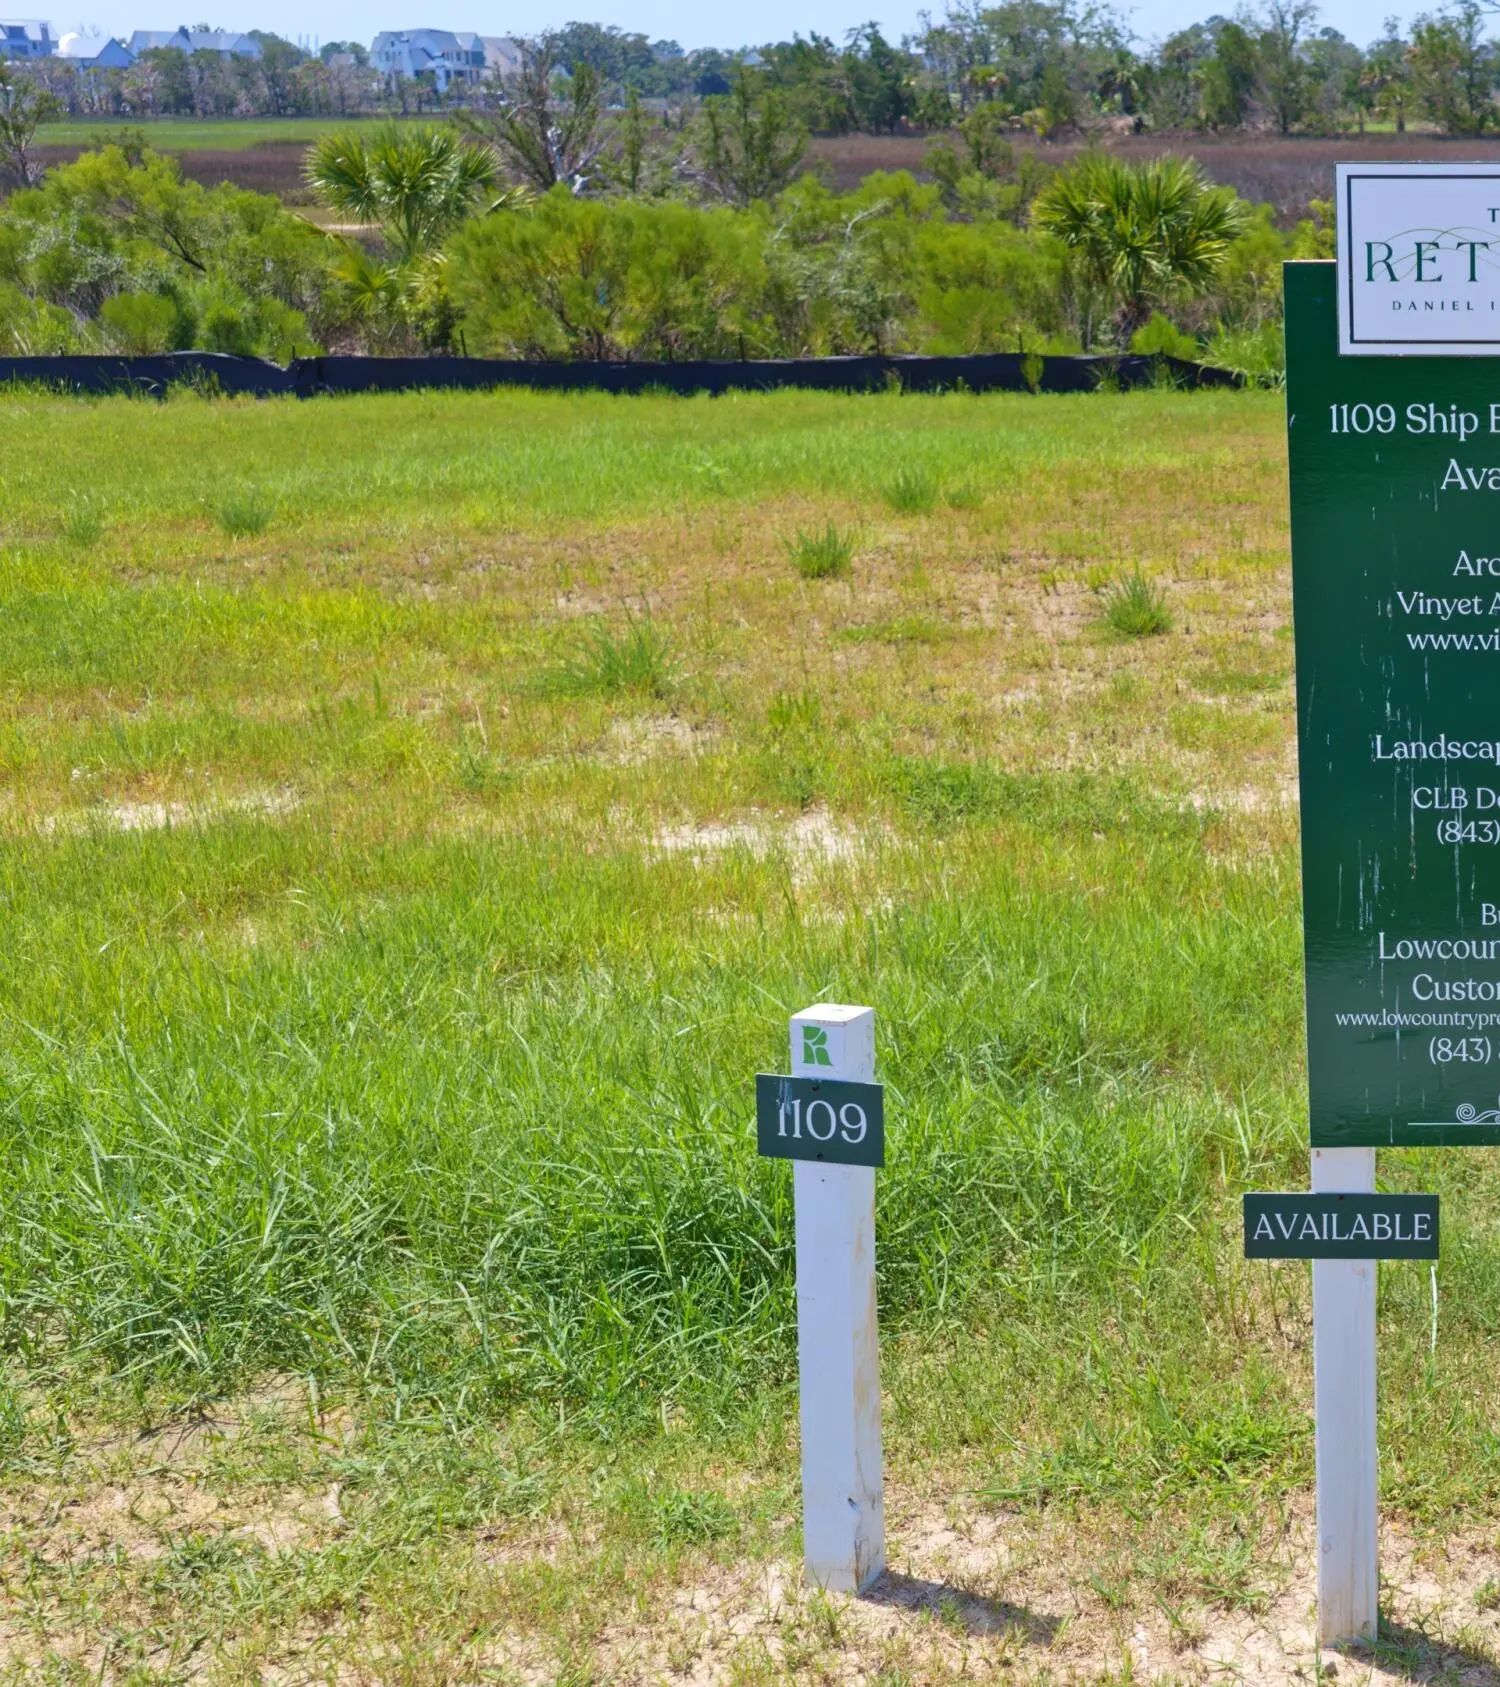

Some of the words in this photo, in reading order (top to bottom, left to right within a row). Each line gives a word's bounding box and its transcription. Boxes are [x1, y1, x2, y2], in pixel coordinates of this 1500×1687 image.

[1391, 299, 1475, 312] DANIEL
[1329, 403, 1396, 434] 1109
[1406, 402, 1478, 442] Ship
[1396, 591, 1483, 621] Vinyet
[1412, 787, 1469, 811] CLB
[1436, 820, 1500, 845] (843)
[1429, 1036, 1492, 1064] (843)
[777, 1099, 867, 1144] 1109
[1253, 1213, 1432, 1241] AVAILABLE
